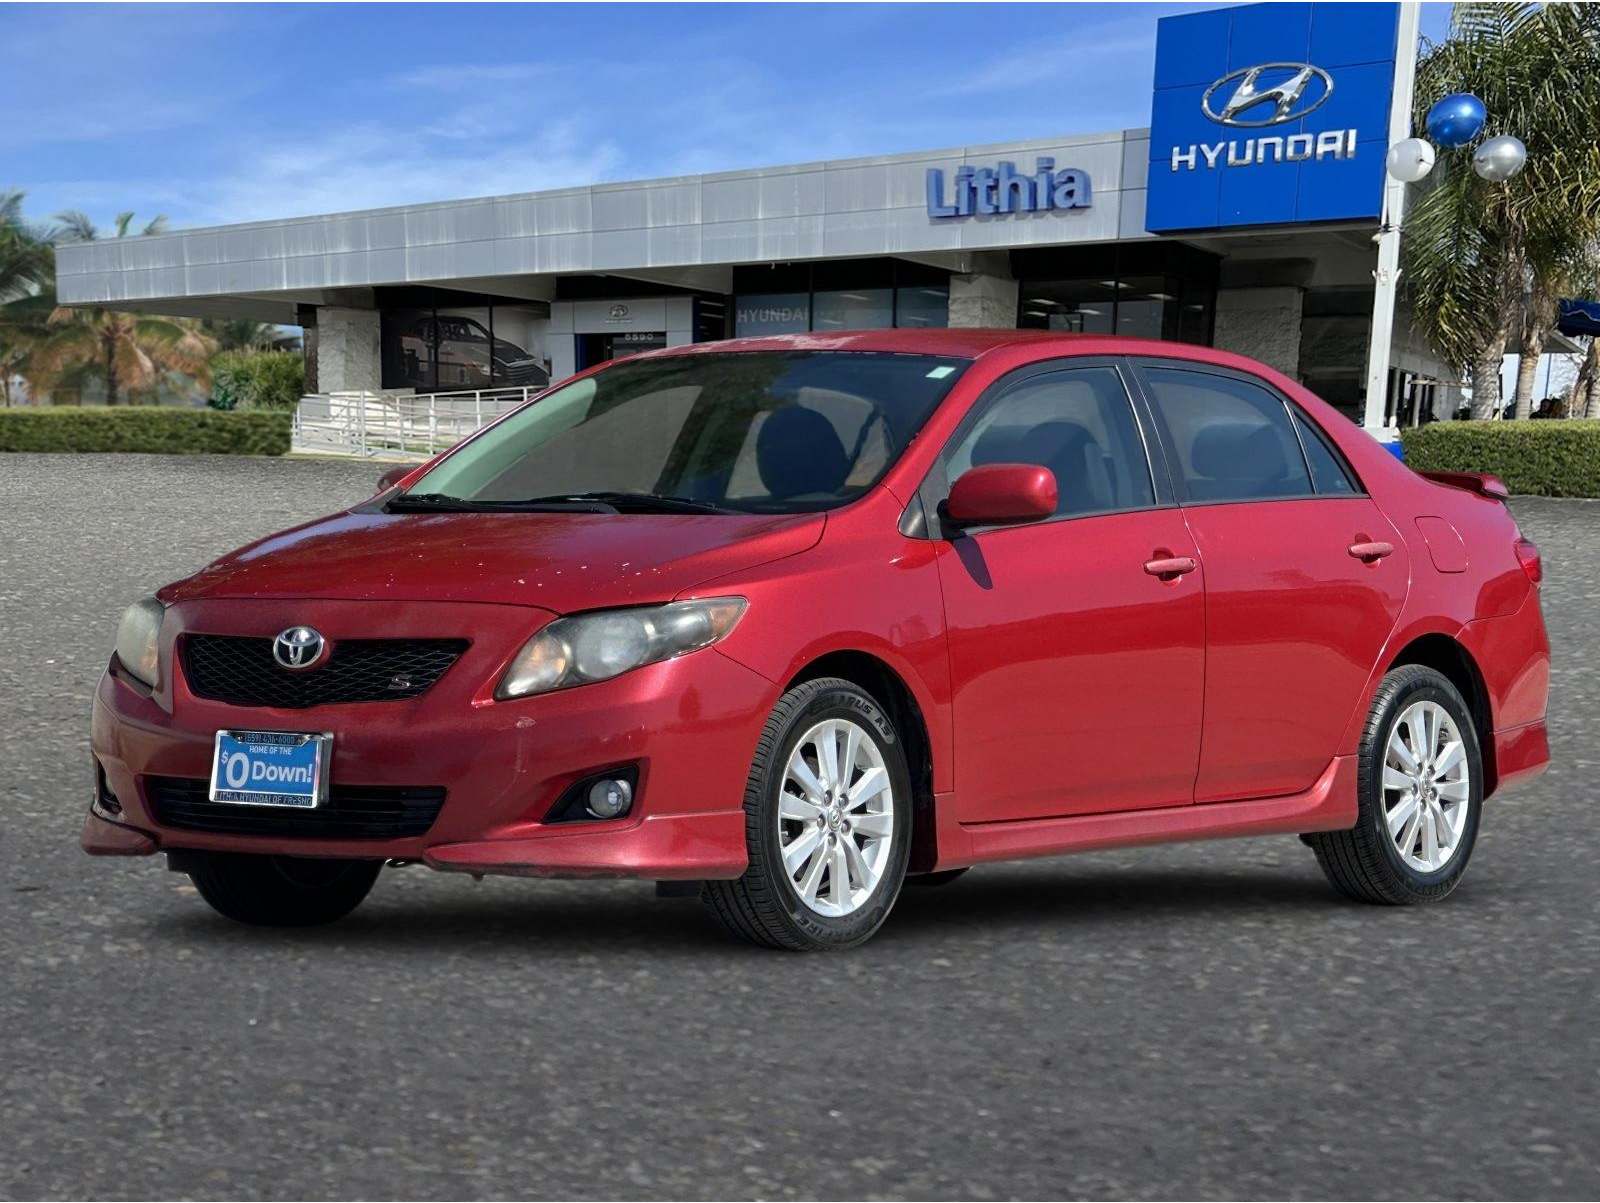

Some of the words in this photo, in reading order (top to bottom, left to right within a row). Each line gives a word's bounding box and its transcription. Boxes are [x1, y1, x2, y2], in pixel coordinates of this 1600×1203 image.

[1171, 128, 1357, 172] HYUNDAI
[926, 156, 1092, 219] Lithia
[736, 307, 809, 323] HYUNDAI
[249, 745, 270, 754] HOME
[270, 746, 278, 754] OF
[279, 746, 293, 756] THE
[252, 761, 313, 783] Down!
[240, 792, 272, 804] HYUNDAI
[283, 796, 312, 806] FRESNO
